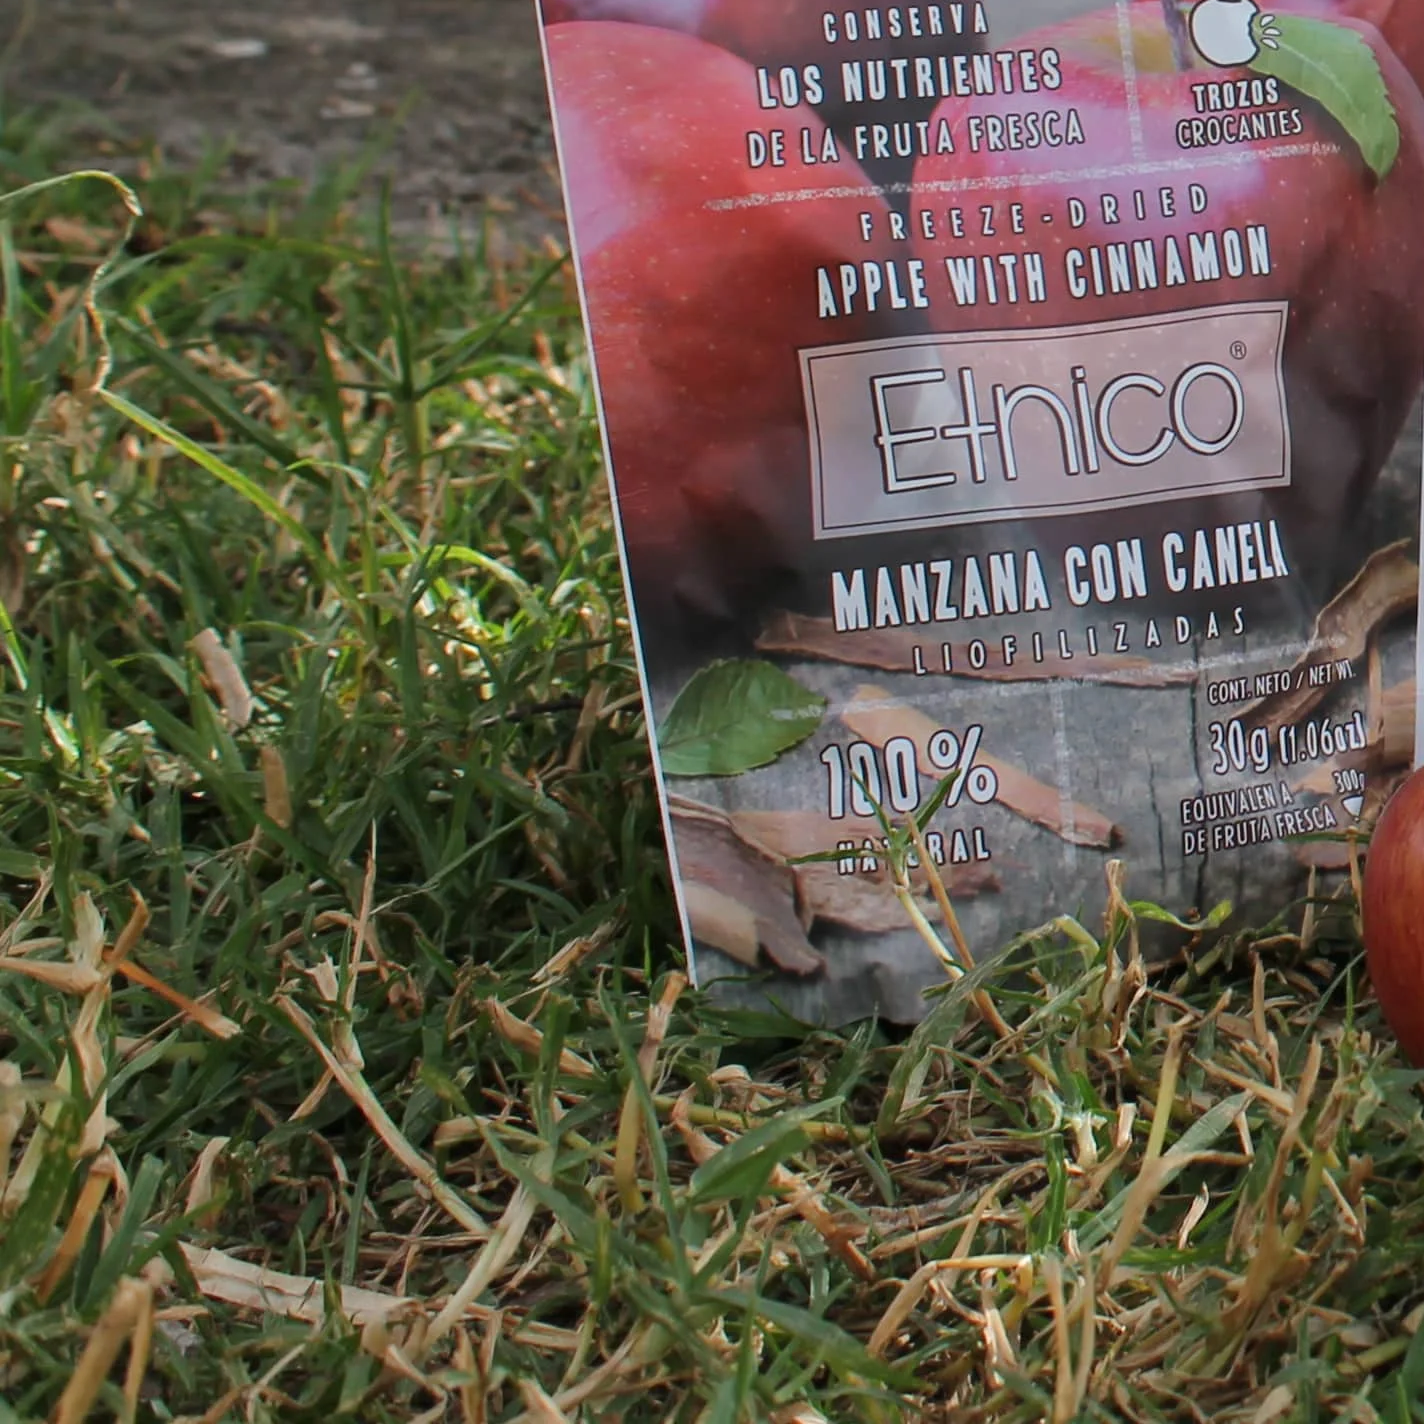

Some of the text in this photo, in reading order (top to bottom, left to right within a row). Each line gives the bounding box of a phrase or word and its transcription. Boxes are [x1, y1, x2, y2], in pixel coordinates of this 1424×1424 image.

[822, 1, 989, 43] CONSERVA
[757, 48, 1061, 109] LOS NUTRIENTES
[1192, 78, 1279, 113] TROZOS
[747, 108, 1085, 168] DE LA FRUTA FRESCA
[1176, 108, 1303, 149] CROCANTES
[816, 225, 1271, 320] APPLE WITH CINNAMON
[831, 518, 1289, 634] MANZANA CON CANELA
[912, 606, 1246, 676] LIOFILIZADAS
[1208, 679, 1252, 705] CONT.
[1255, 671, 1290, 697] NETO
[1296, 672, 1304, 689] /
[1309, 663, 1331, 687] NET
[1209, 718, 1270, 774] 30g
[1181, 781, 1294, 825] EQUIVALEN A
[837, 828, 991, 875] NARAL
[1184, 804, 1337, 855] DE FRUTA FRESCA
